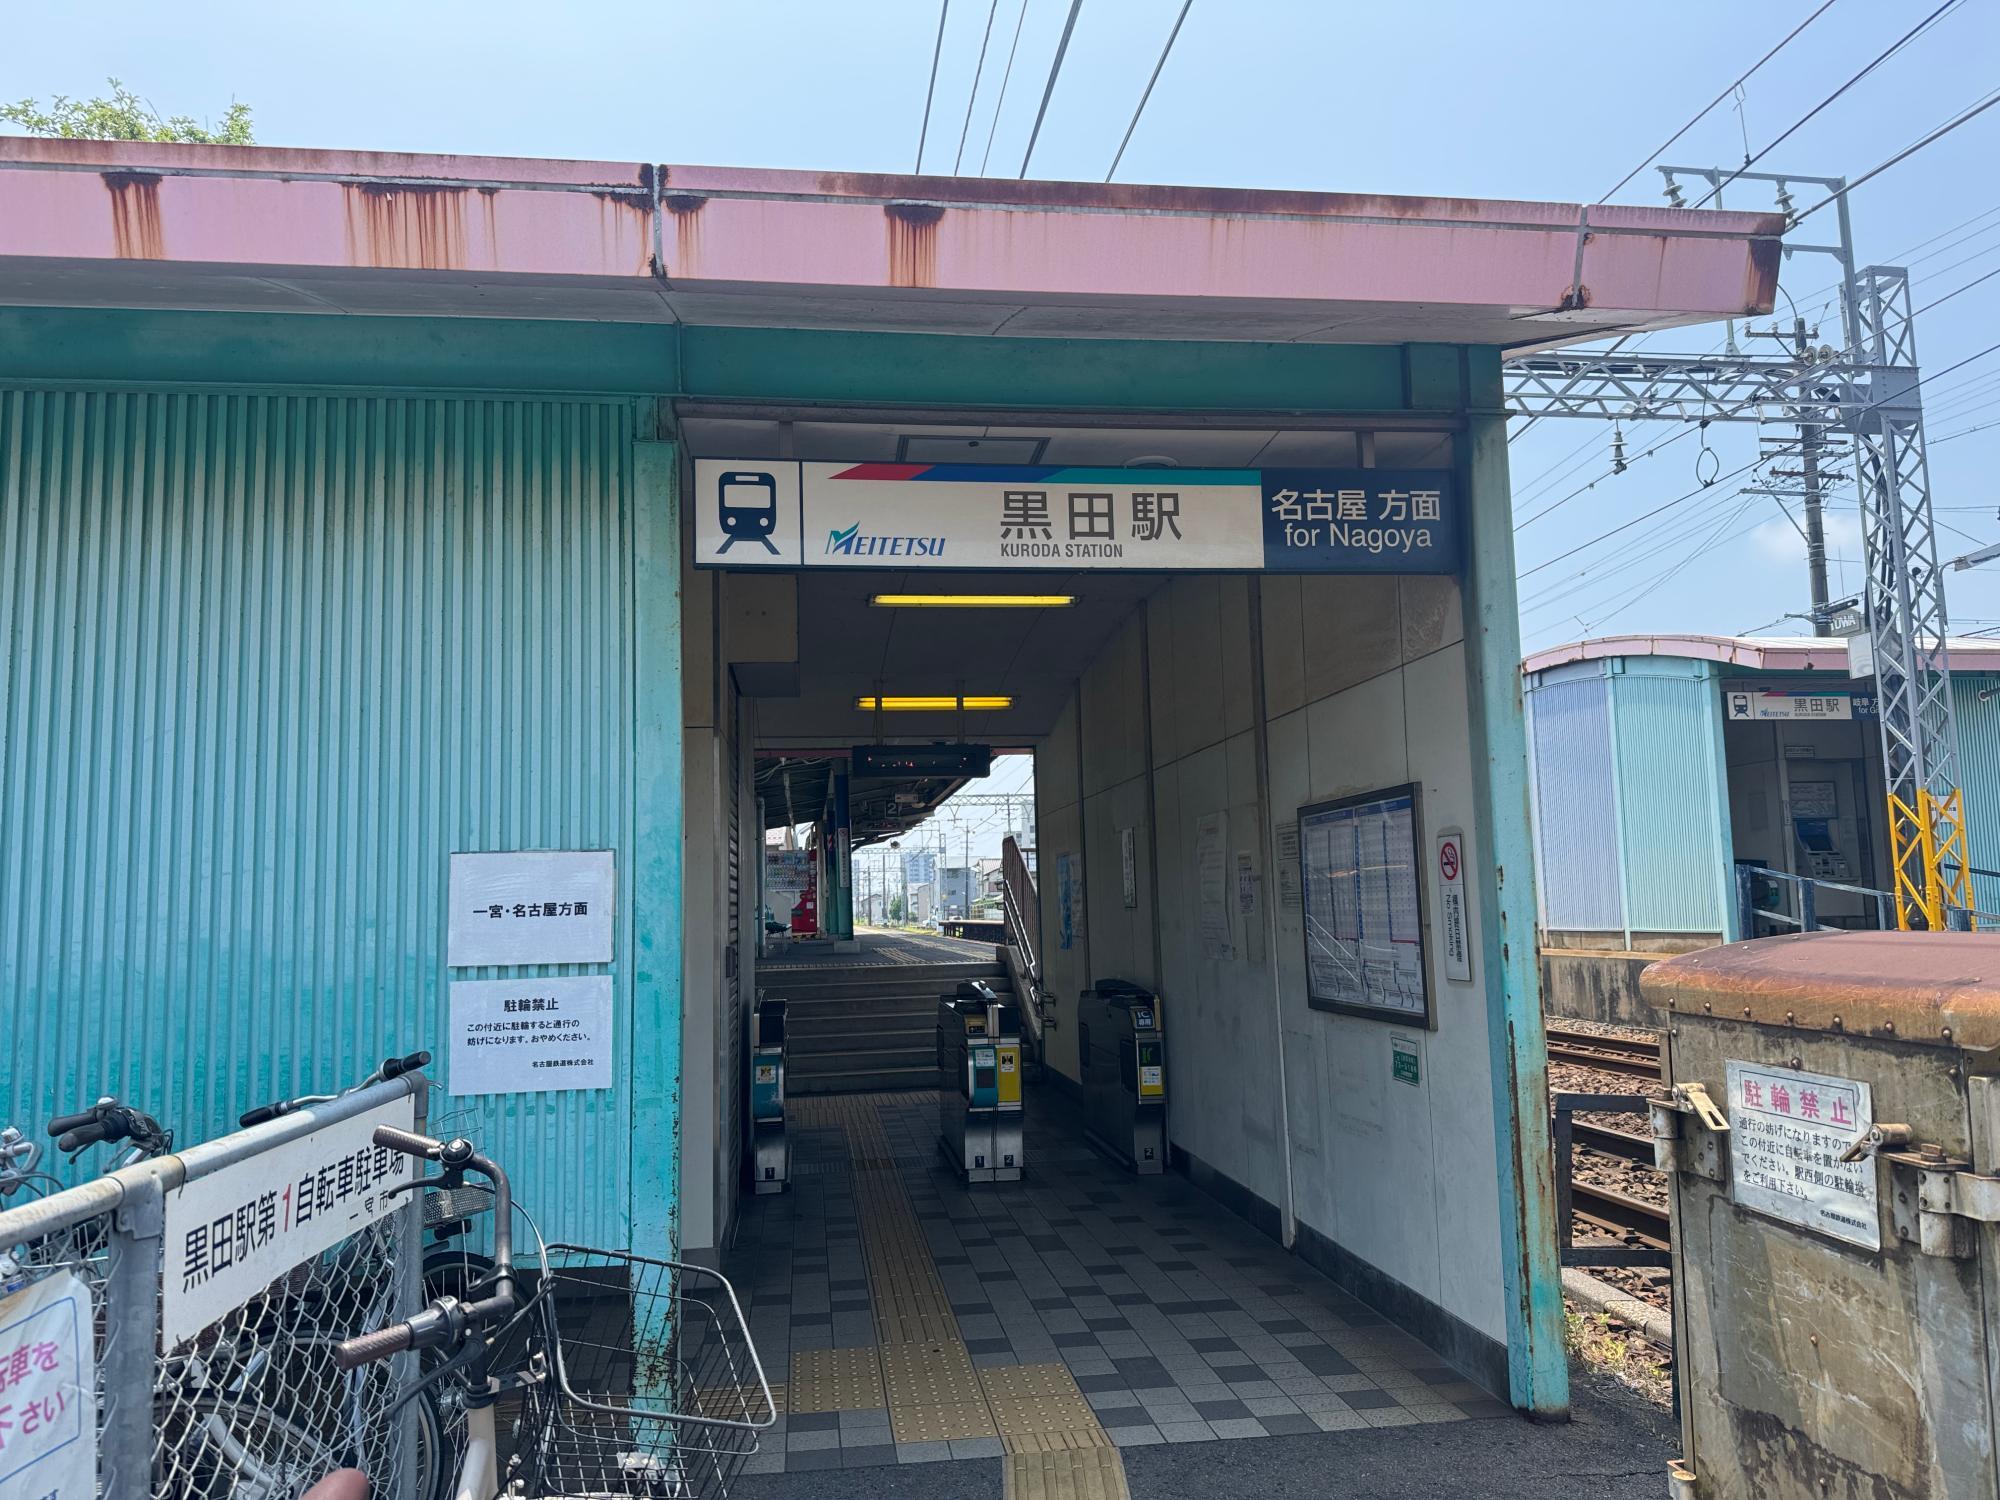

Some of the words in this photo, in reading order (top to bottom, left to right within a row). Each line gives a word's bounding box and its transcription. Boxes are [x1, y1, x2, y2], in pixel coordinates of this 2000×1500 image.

[1271, 488, 1368, 522] 名古屋
[1378, 489, 1441, 522] 方面
[1001, 491, 1182, 542] 黒田駅
[825, 520, 946, 557] MEITETSU
[1285, 523, 1320, 547] for
[1330, 524, 1433, 554] Nagoya
[1001, 543, 1061, 558] KURODA
[1065, 544, 1123, 559] STATION
[1793, 698, 1840, 713] 黒田駅
[472, 901, 589, 919] 一宮・名古屋方面
[503, 997, 560, 1013] 駐輪禁止
[466, 1018, 581, 1033] この付近に駐輪すると通行の
[466, 1032, 592, 1046] 妨げになります。おやめください。
[531, 1057, 595, 1068] 名古屋鉄道株式会社
[1743, 1079, 1852, 1125] 駐輪禁止
[182, 1145, 404, 1293] 黒田駅第1自転車駐車場
